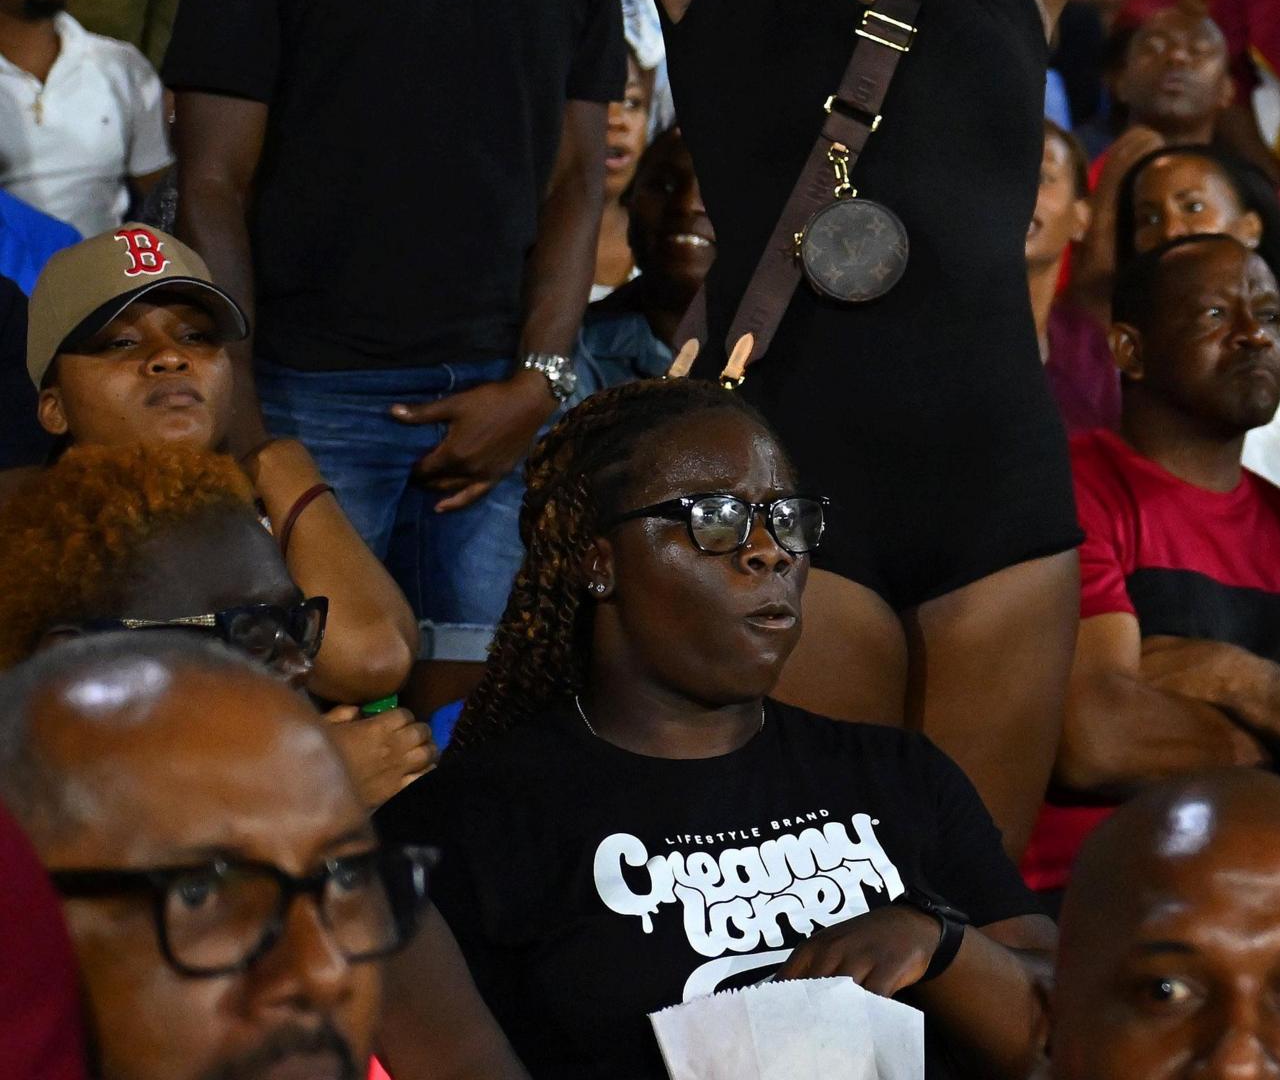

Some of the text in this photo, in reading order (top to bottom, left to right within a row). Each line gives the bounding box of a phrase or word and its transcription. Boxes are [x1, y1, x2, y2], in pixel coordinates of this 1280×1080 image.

[113, 228, 171, 277] B
[665, 808, 830, 845] LIFESTYLE BRAND
[593, 812, 905, 934] Creamy
